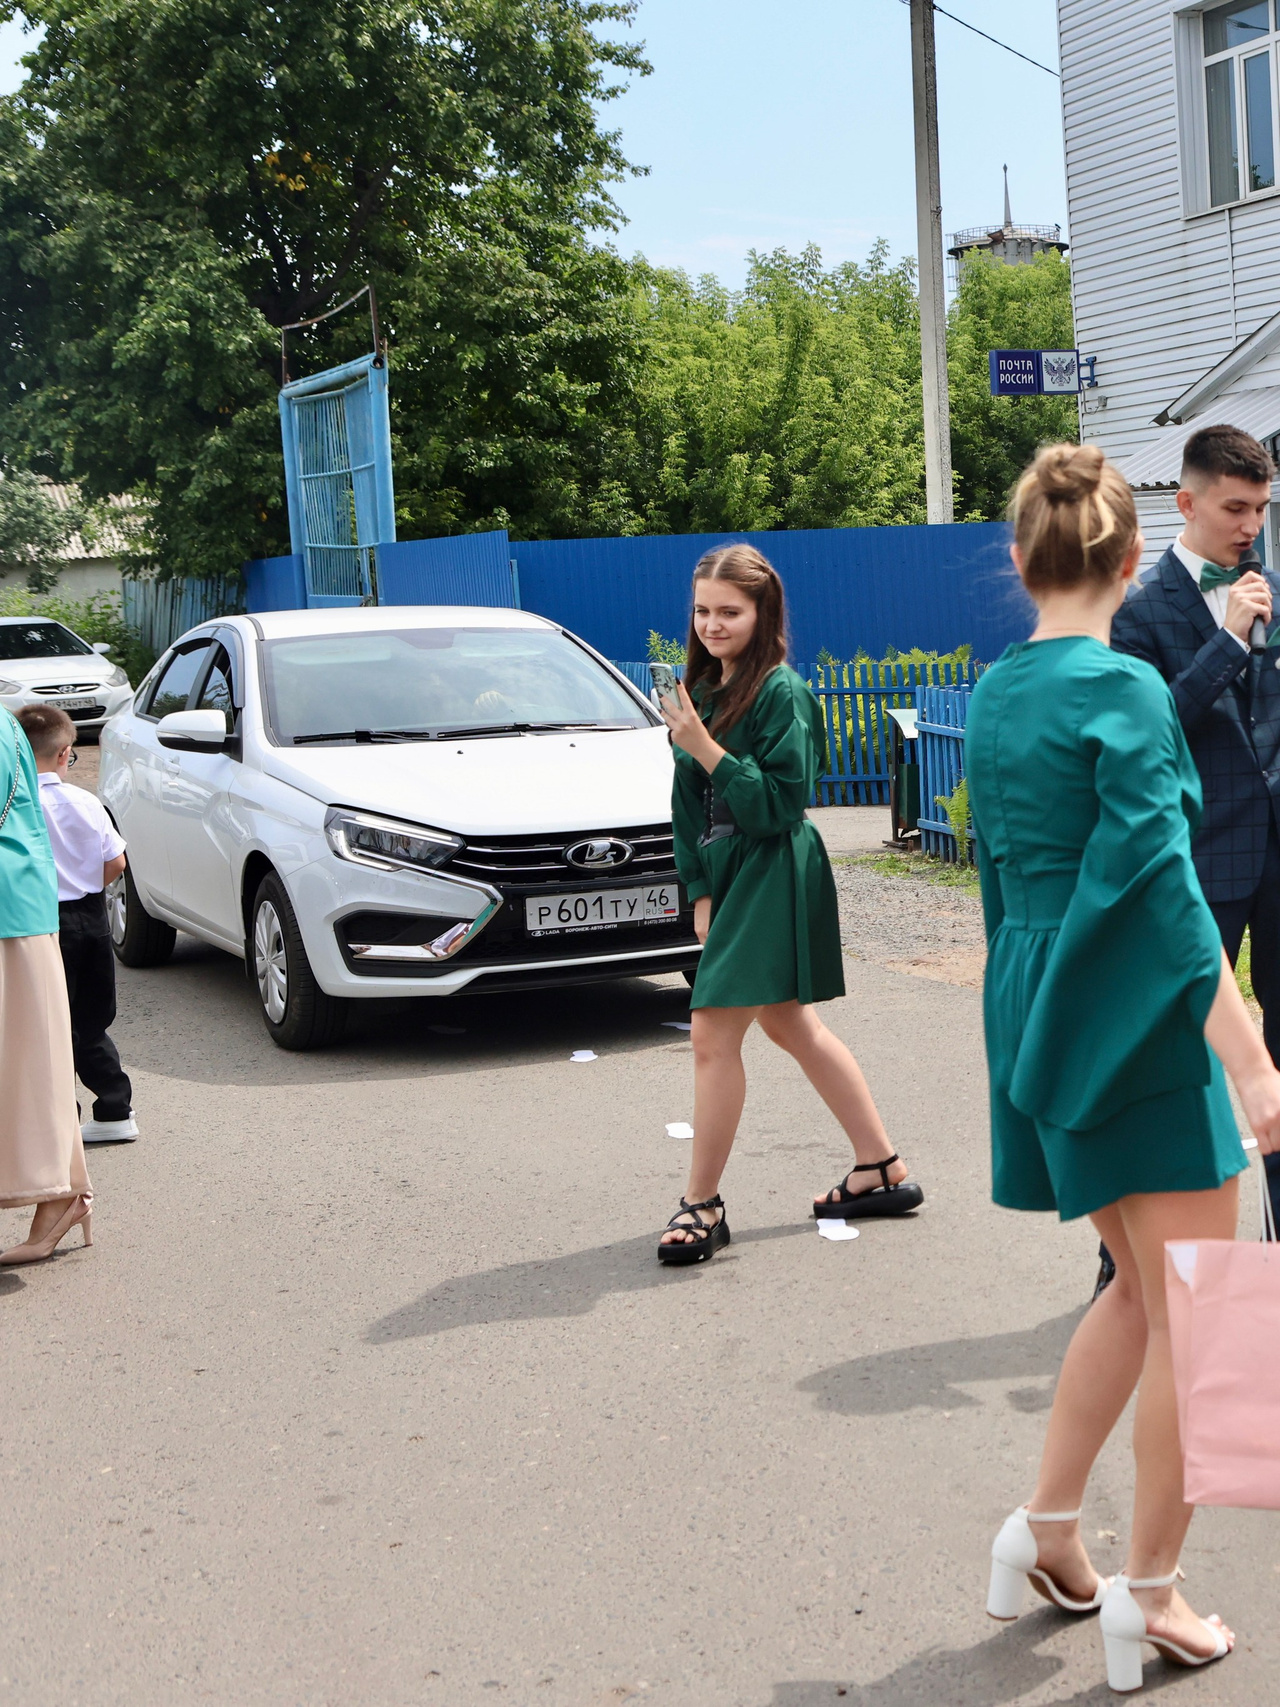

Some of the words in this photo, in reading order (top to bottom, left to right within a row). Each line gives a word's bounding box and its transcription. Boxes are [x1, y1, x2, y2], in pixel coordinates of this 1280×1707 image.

[999, 360, 1034, 371] ПОЧТА
[999, 373, 1034, 384] РОССИИ
[538, 895, 638, 926] Р601ТУ
[647, 888, 669, 907] 46
[645, 907, 664, 916] RUS
